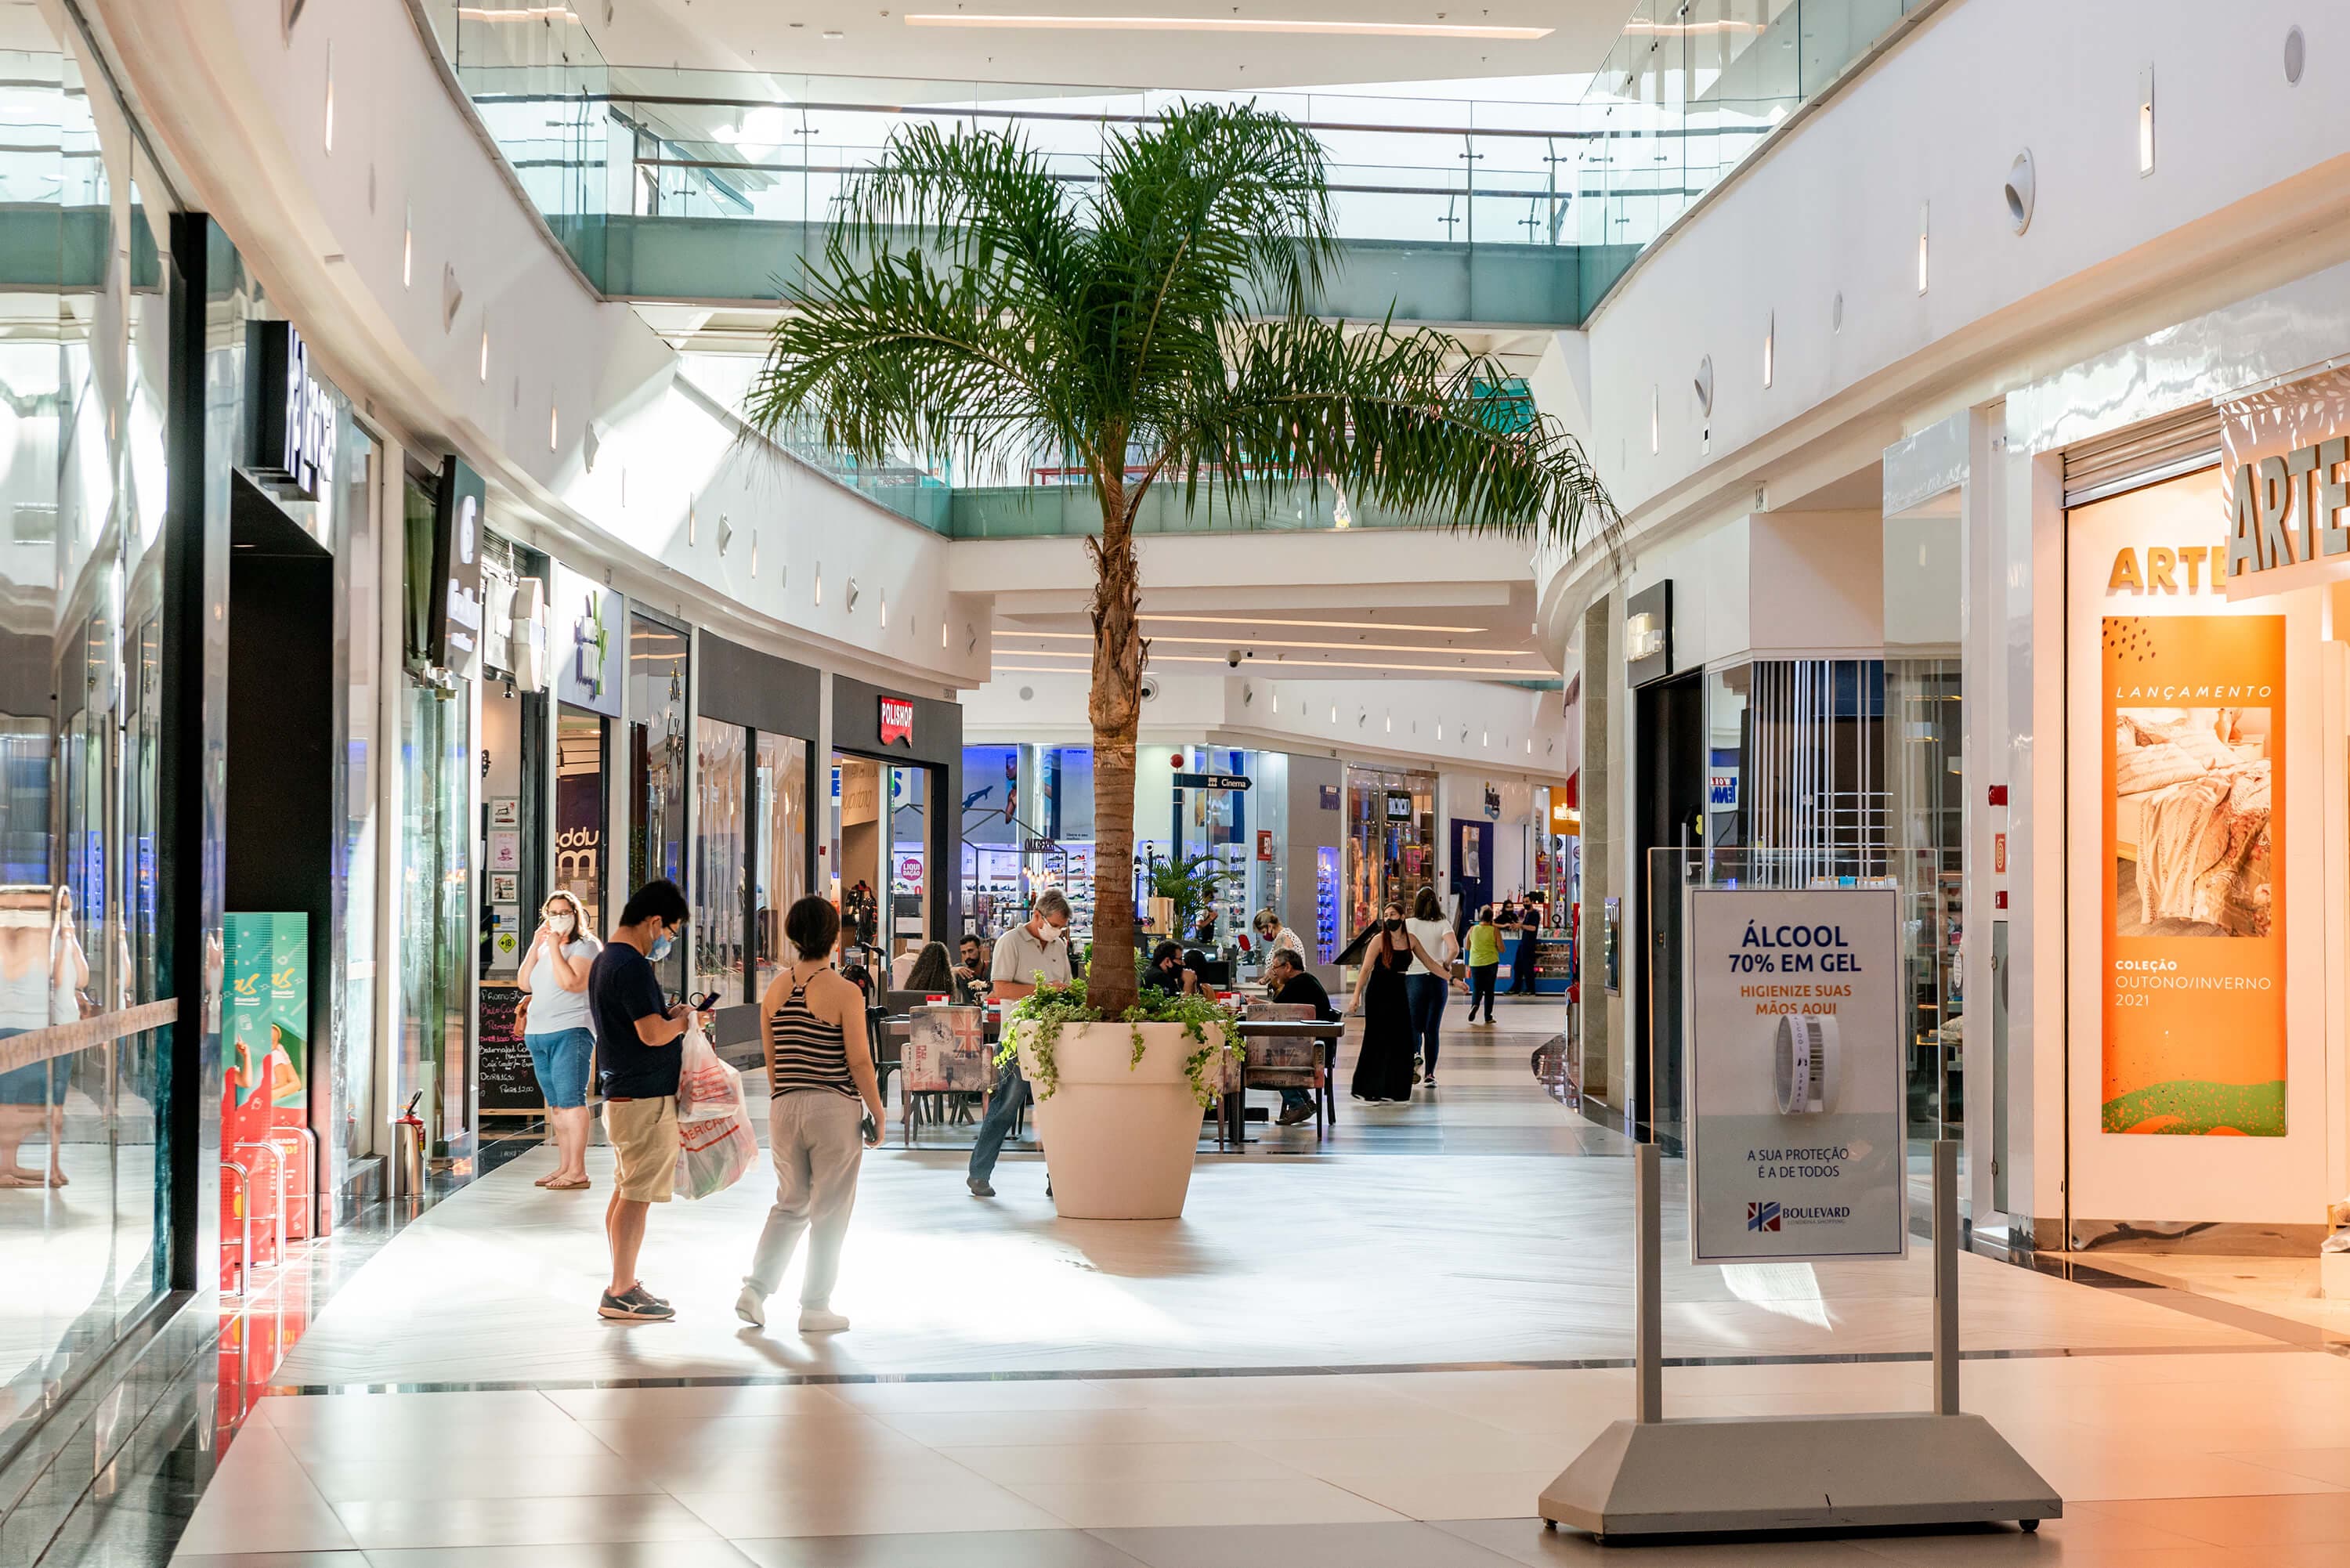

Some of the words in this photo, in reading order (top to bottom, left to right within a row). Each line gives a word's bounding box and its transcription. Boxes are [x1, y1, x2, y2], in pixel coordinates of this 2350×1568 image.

[2229, 435, 2350, 577] ARTE
[2116, 685, 2272, 701] LANÇAMENTO
[882, 703, 913, 728] POLISHOP
[1221, 779, 1246, 788] Cinema
[1741, 919, 1849, 948] ÁLCOOL
[1728, 953, 1775, 973] 70%
[1781, 954, 1813, 972] EM
[1820, 953, 1862, 972] GEL
[2115, 958, 2178, 973] COLEÇÃO
[2115, 976, 2272, 990] OUTONO/INVERNO
[1741, 985, 1812, 998] HIGIENIZE
[1815, 985, 1852, 997] SUAS
[2115, 993, 2149, 1006] 2021
[1755, 1000, 1798, 1015] MÃOS
[1747, 1150, 1756, 1162] A
[1759, 1149, 1783, 1161] SUA
[1785, 1147, 1849, 1163] PROTEÇÃO
[1758, 1165, 1765, 1179] É
[1767, 1167, 1777, 1178] A
[1780, 1166, 1795, 1178] DE
[1797, 1165, 1840, 1178] TODOS
[1782, 1206, 1850, 1219] BOULEVARD
